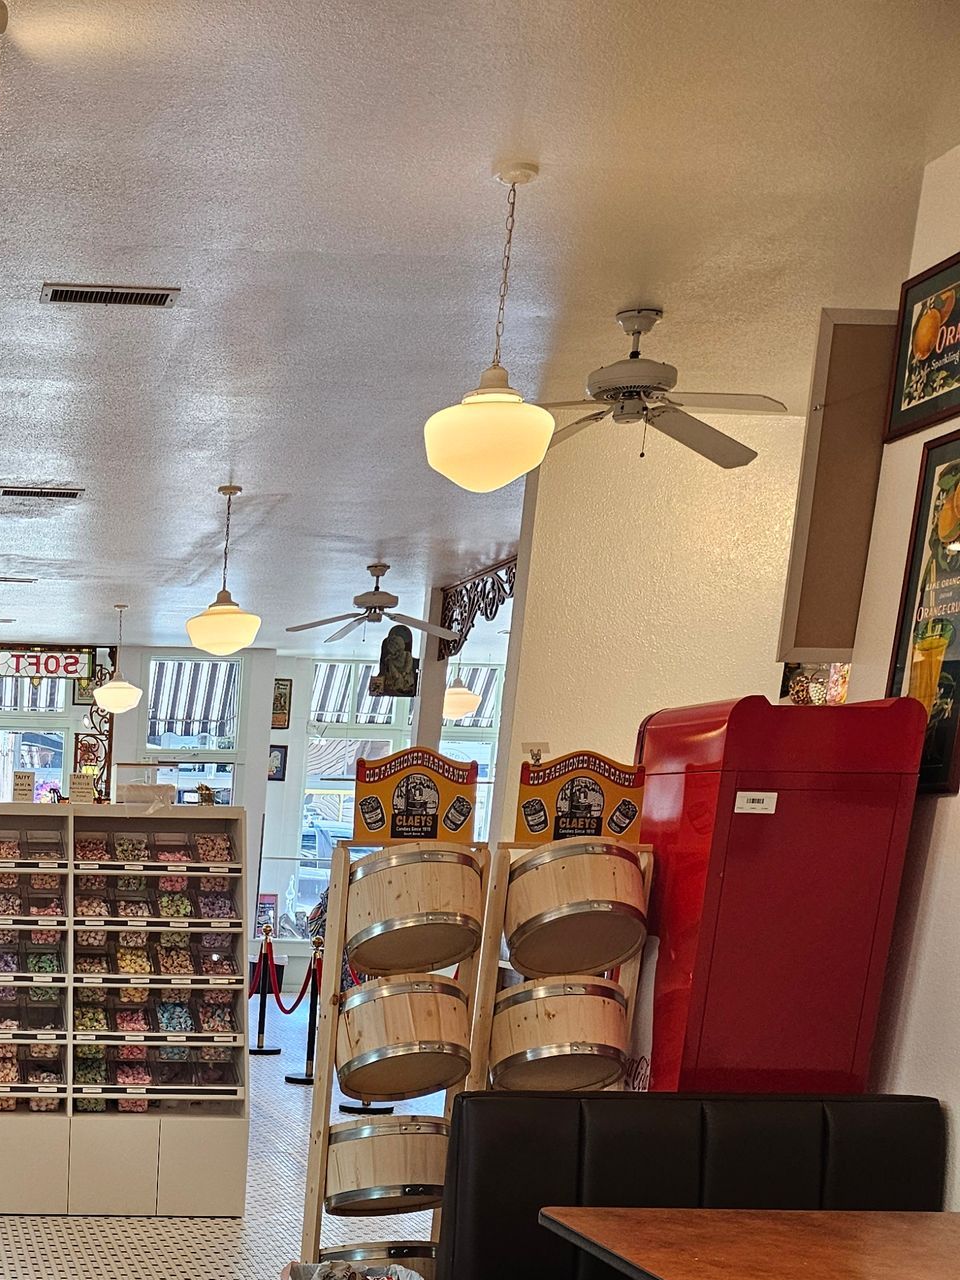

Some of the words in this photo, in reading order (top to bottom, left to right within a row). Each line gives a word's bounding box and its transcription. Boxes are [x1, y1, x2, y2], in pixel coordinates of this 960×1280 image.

[365, 770, 380, 782] OLD
[380, 752, 422, 779] FASHIONED
[424, 753, 443, 773] HARD
[443, 765, 469, 783] CANDY
[529, 771, 544, 784] OLD
[544, 755, 588, 780] FASHIONED
[589, 757, 610, 777] HARD
[610, 769, 635, 786] CANDY
[395, 815, 433, 826] CLAEYS
[559, 818, 597, 829] CLAEYS
